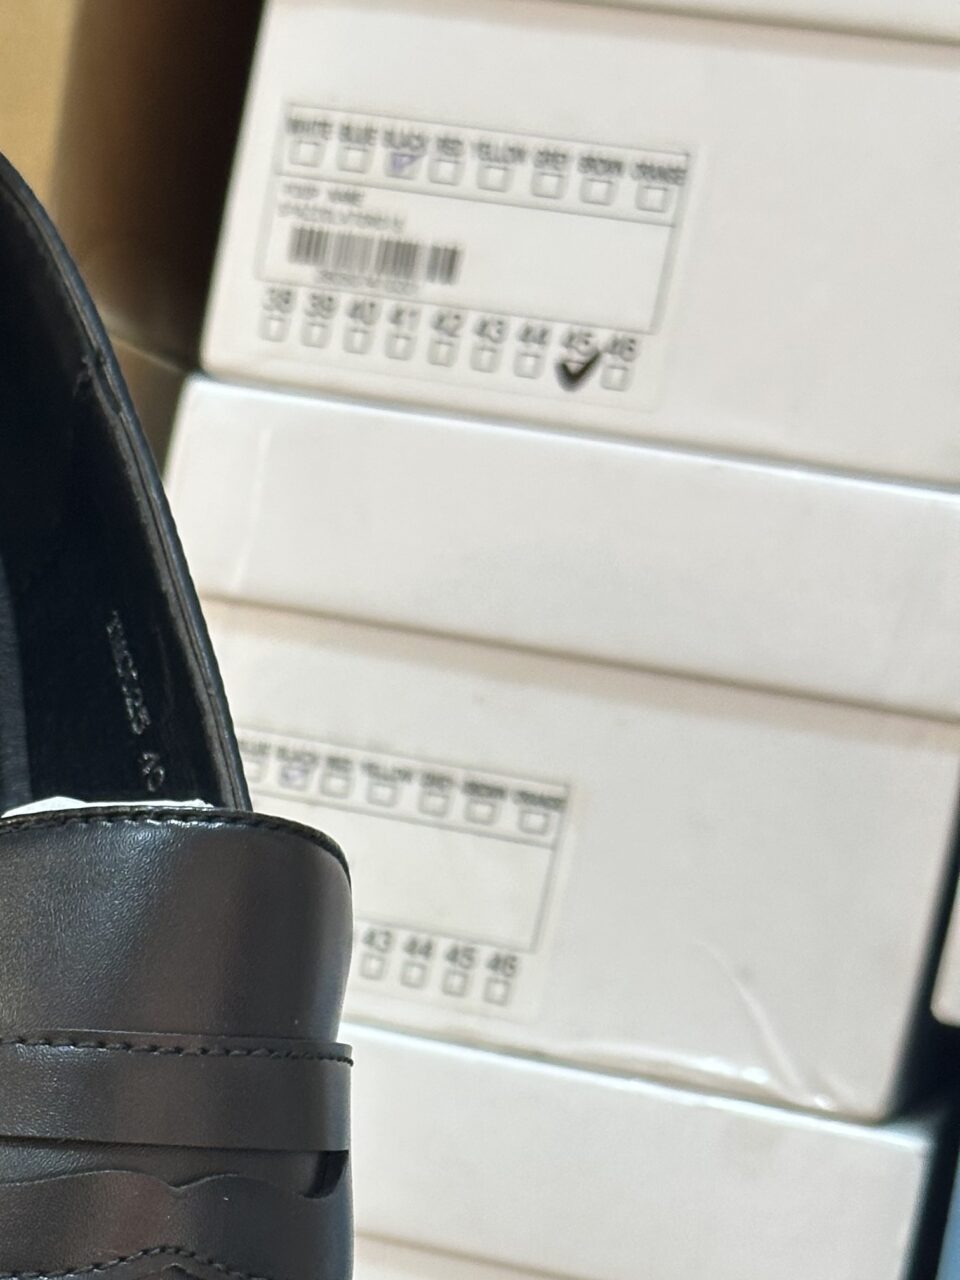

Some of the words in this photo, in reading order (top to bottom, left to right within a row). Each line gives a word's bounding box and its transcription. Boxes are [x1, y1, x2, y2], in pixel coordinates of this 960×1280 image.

[431, 314, 462, 338] 42
[473, 319, 504, 344] 43
[516, 326, 550, 347] 44
[362, 928, 392, 953] 43
[403, 937, 433, 959] 44
[445, 946, 477, 969] 45
[487, 954, 518, 977] 46
